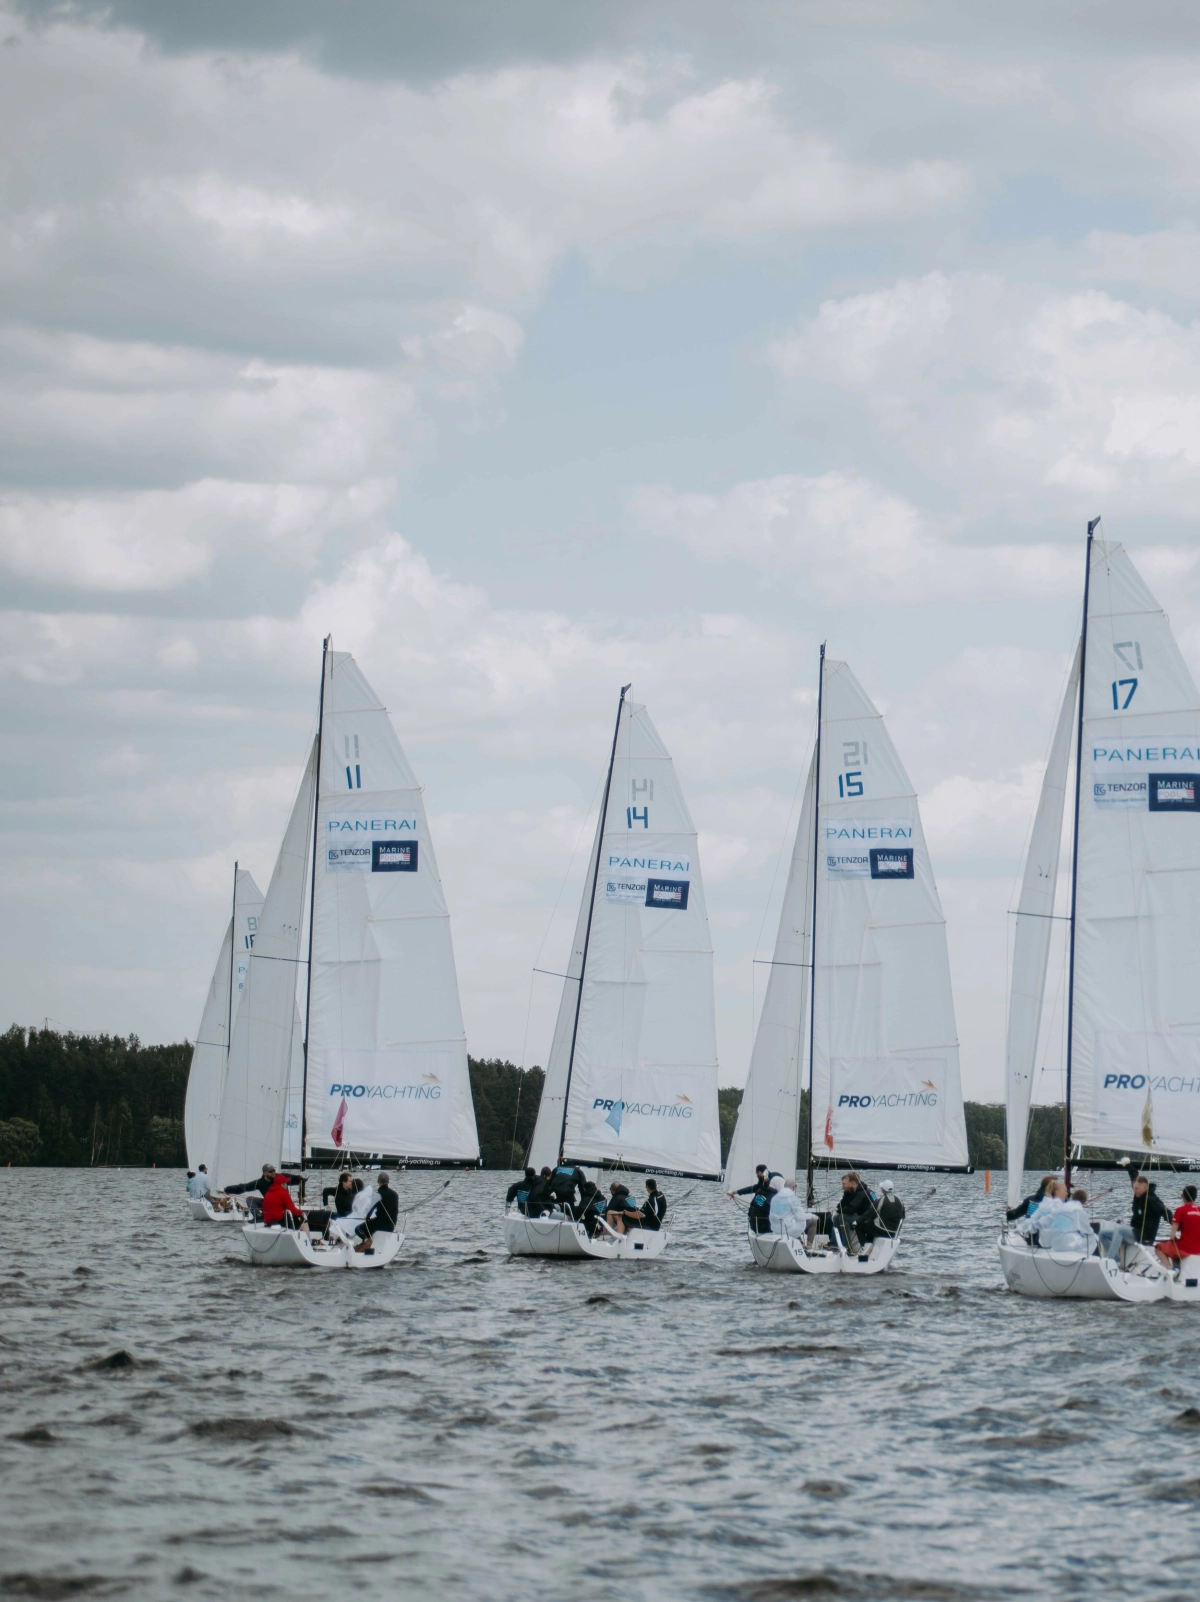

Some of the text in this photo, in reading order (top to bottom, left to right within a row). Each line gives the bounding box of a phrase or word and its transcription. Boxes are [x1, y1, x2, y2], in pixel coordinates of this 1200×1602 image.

[1111, 678, 1138, 710] 17
[1093, 748, 1200, 762] PANERAI
[346, 764, 361, 789] 11
[838, 771, 863, 798] 15
[1108, 783, 1146, 792] TENZOR
[1157, 780, 1194, 788] MARINE
[626, 806, 648, 828] 14
[328, 820, 416, 832] PANERAI
[826, 827, 912, 839] PANERAI
[340, 848, 370, 856] TENZOR
[608, 856, 690, 872] PANERAI
[837, 856, 869, 864] TENZOR
[617, 883, 646, 892] TENZOR
[654, 884, 682, 892] MARINE
[330, 1083, 442, 1099] PROYACHTING
[838, 1093, 937, 1108] PROYACHTING
[399, 1158, 441, 1166] pro-yachting.ru
[645, 1168, 684, 1177] pro-yachting.ru
[897, 1164, 936, 1172] pro-yachting.ru
[1108, 1268, 1118, 1277] 17
